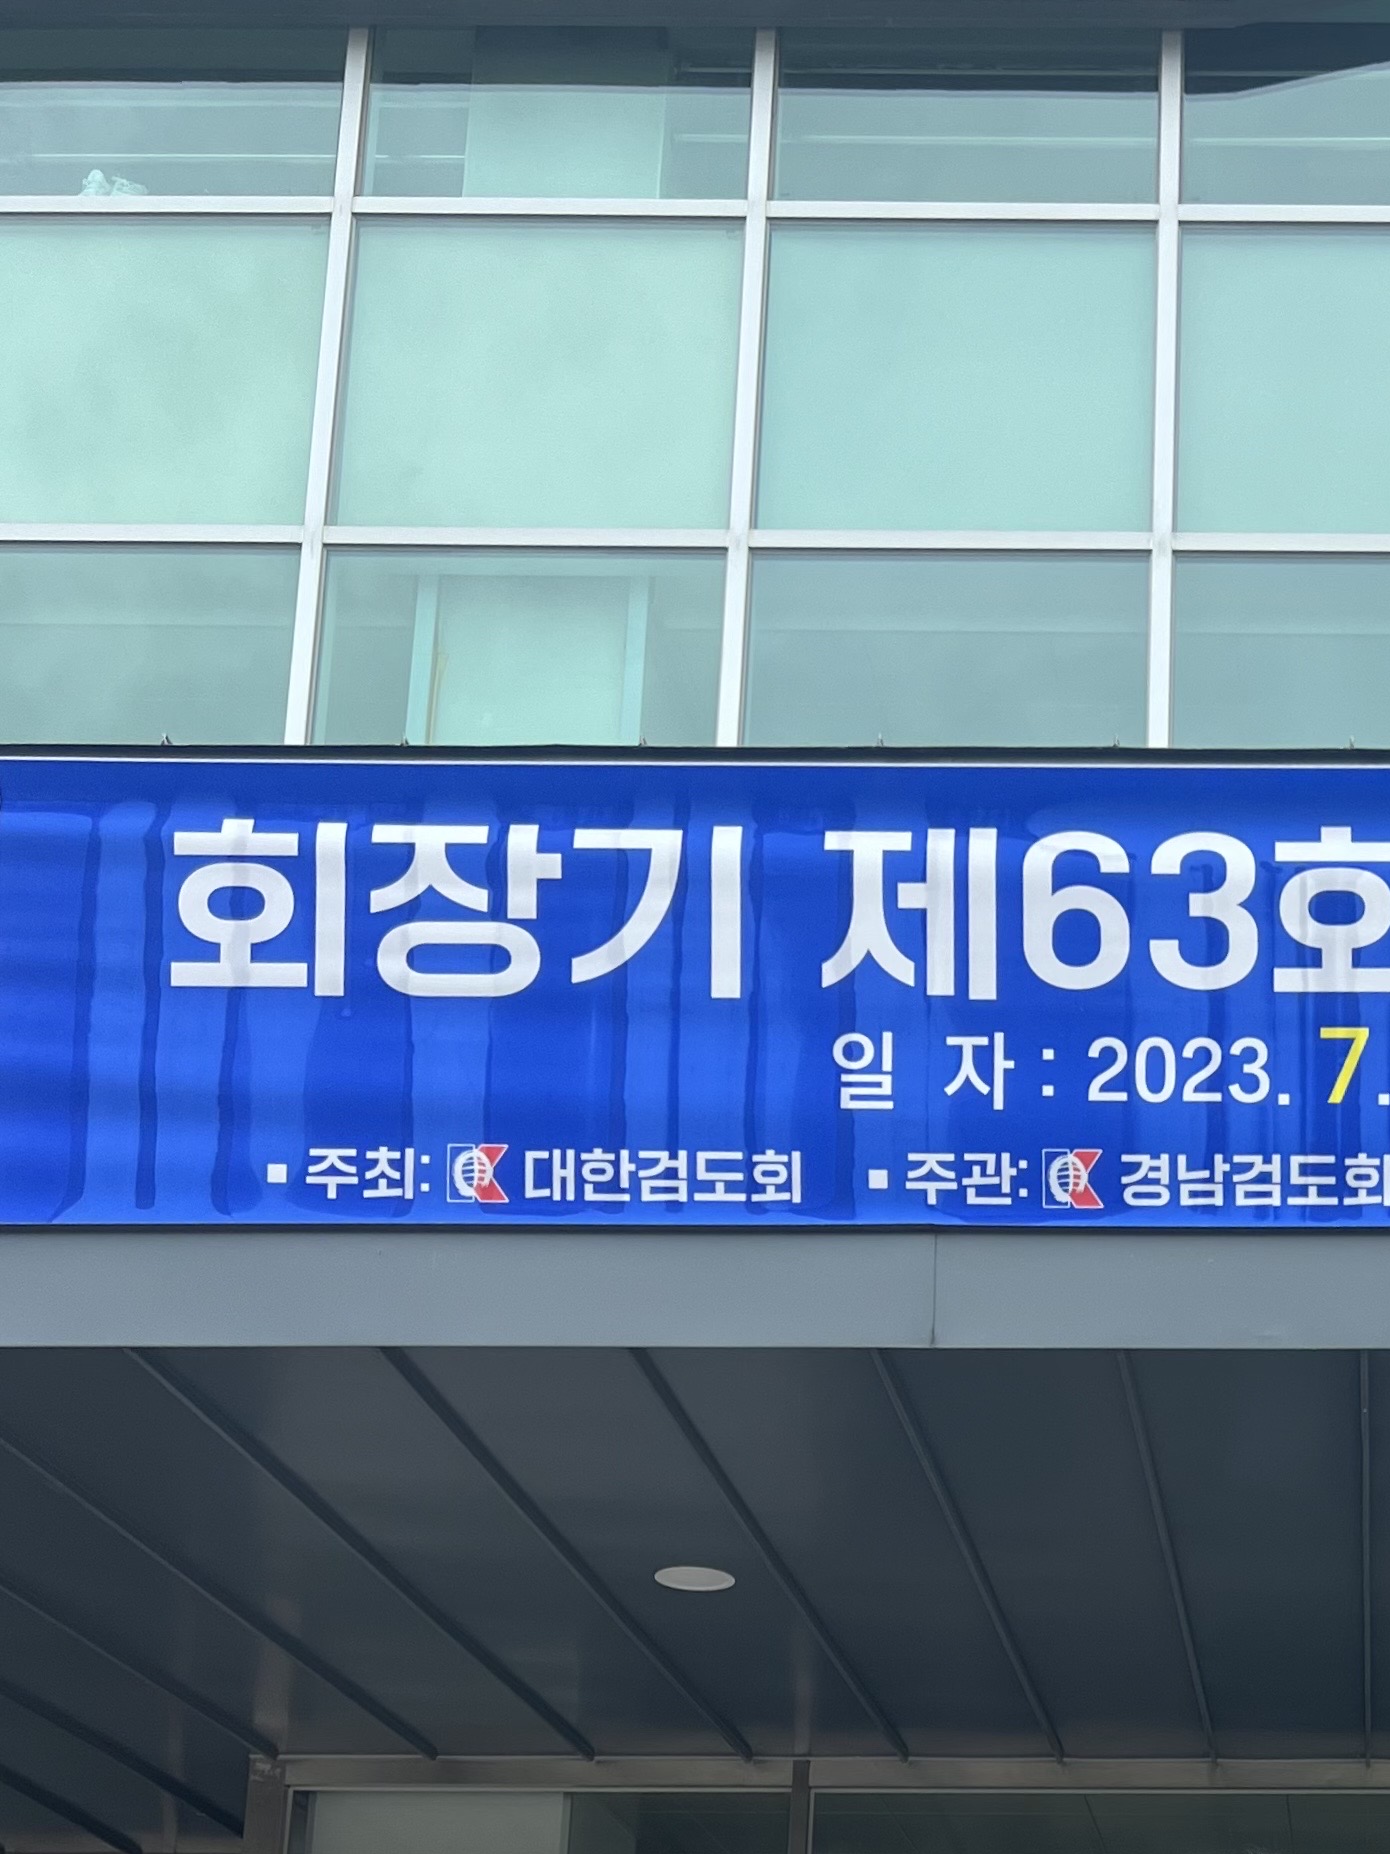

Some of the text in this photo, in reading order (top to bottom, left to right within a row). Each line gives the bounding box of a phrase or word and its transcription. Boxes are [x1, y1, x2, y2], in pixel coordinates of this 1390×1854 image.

[171, 819, 742, 998] 회장기
[834, 1032, 893, 1109] 일
[945, 1033, 1014, 1109] 자
[1089, 1037, 1289, 1105] 2023.
[1321, 1027, 1389, 1105] 7.
[526, 1149, 801, 1203] 대한검도회
